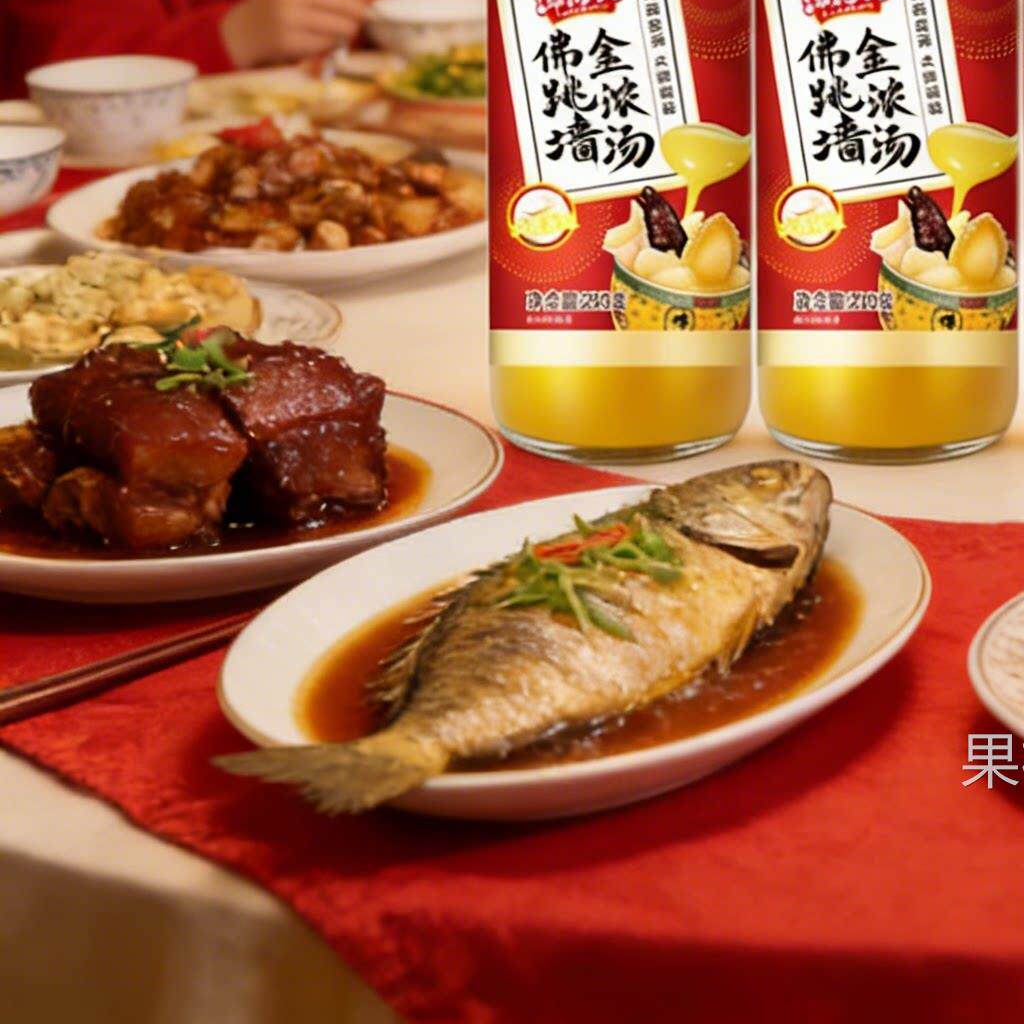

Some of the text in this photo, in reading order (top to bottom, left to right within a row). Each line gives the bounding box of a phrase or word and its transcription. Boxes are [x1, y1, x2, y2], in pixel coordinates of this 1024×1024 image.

[532, 28, 604, 172] 佛跳墙
[588, 27, 655, 173] 金浓汤
[798, 28, 870, 172] 佛跳墙
[854, 27, 921, 173] 金浓汤
